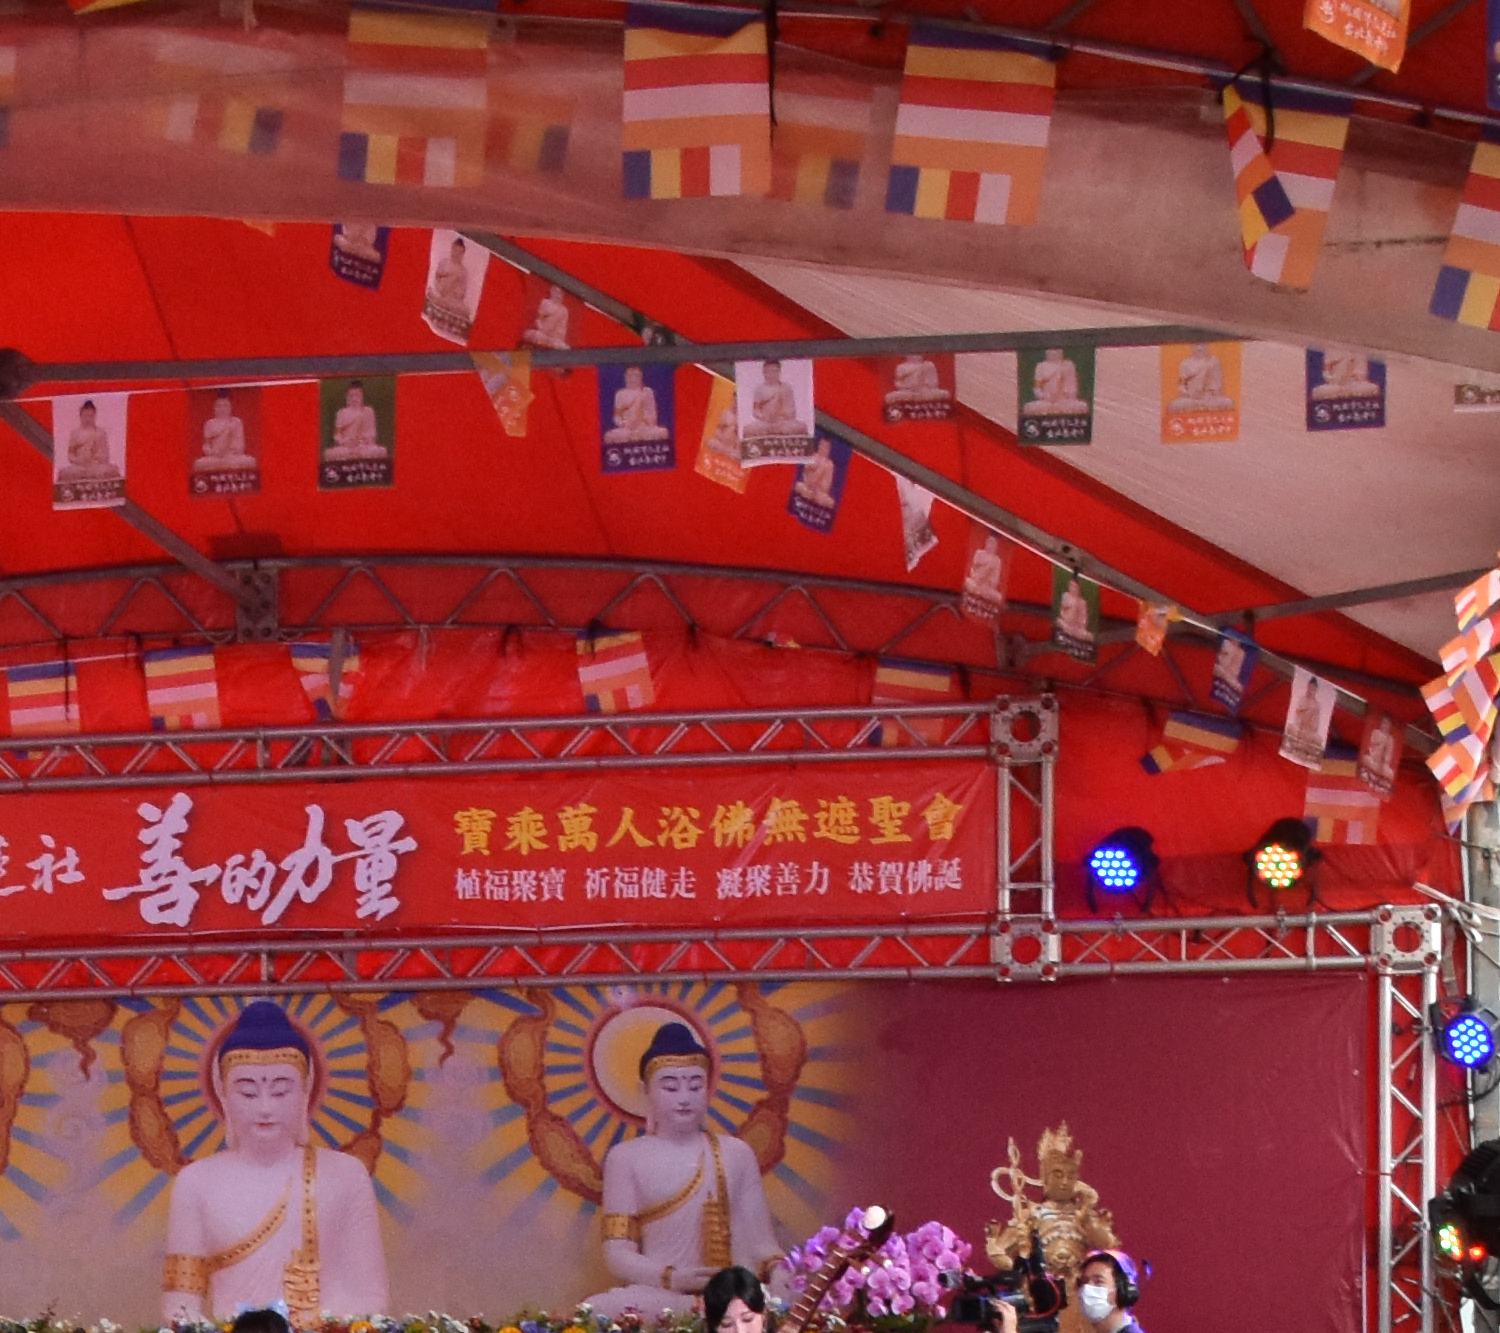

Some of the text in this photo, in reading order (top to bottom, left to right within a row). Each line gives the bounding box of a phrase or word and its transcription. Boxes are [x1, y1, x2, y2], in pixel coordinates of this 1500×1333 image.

[453, 792, 964, 856] 寶乘萬人浴佛無遮聖會
[101, 791, 418, 928] 善的力量
[454, 857, 964, 902] 植福聚寶 祈福健走 凝聚善力 恭賀佛誕
